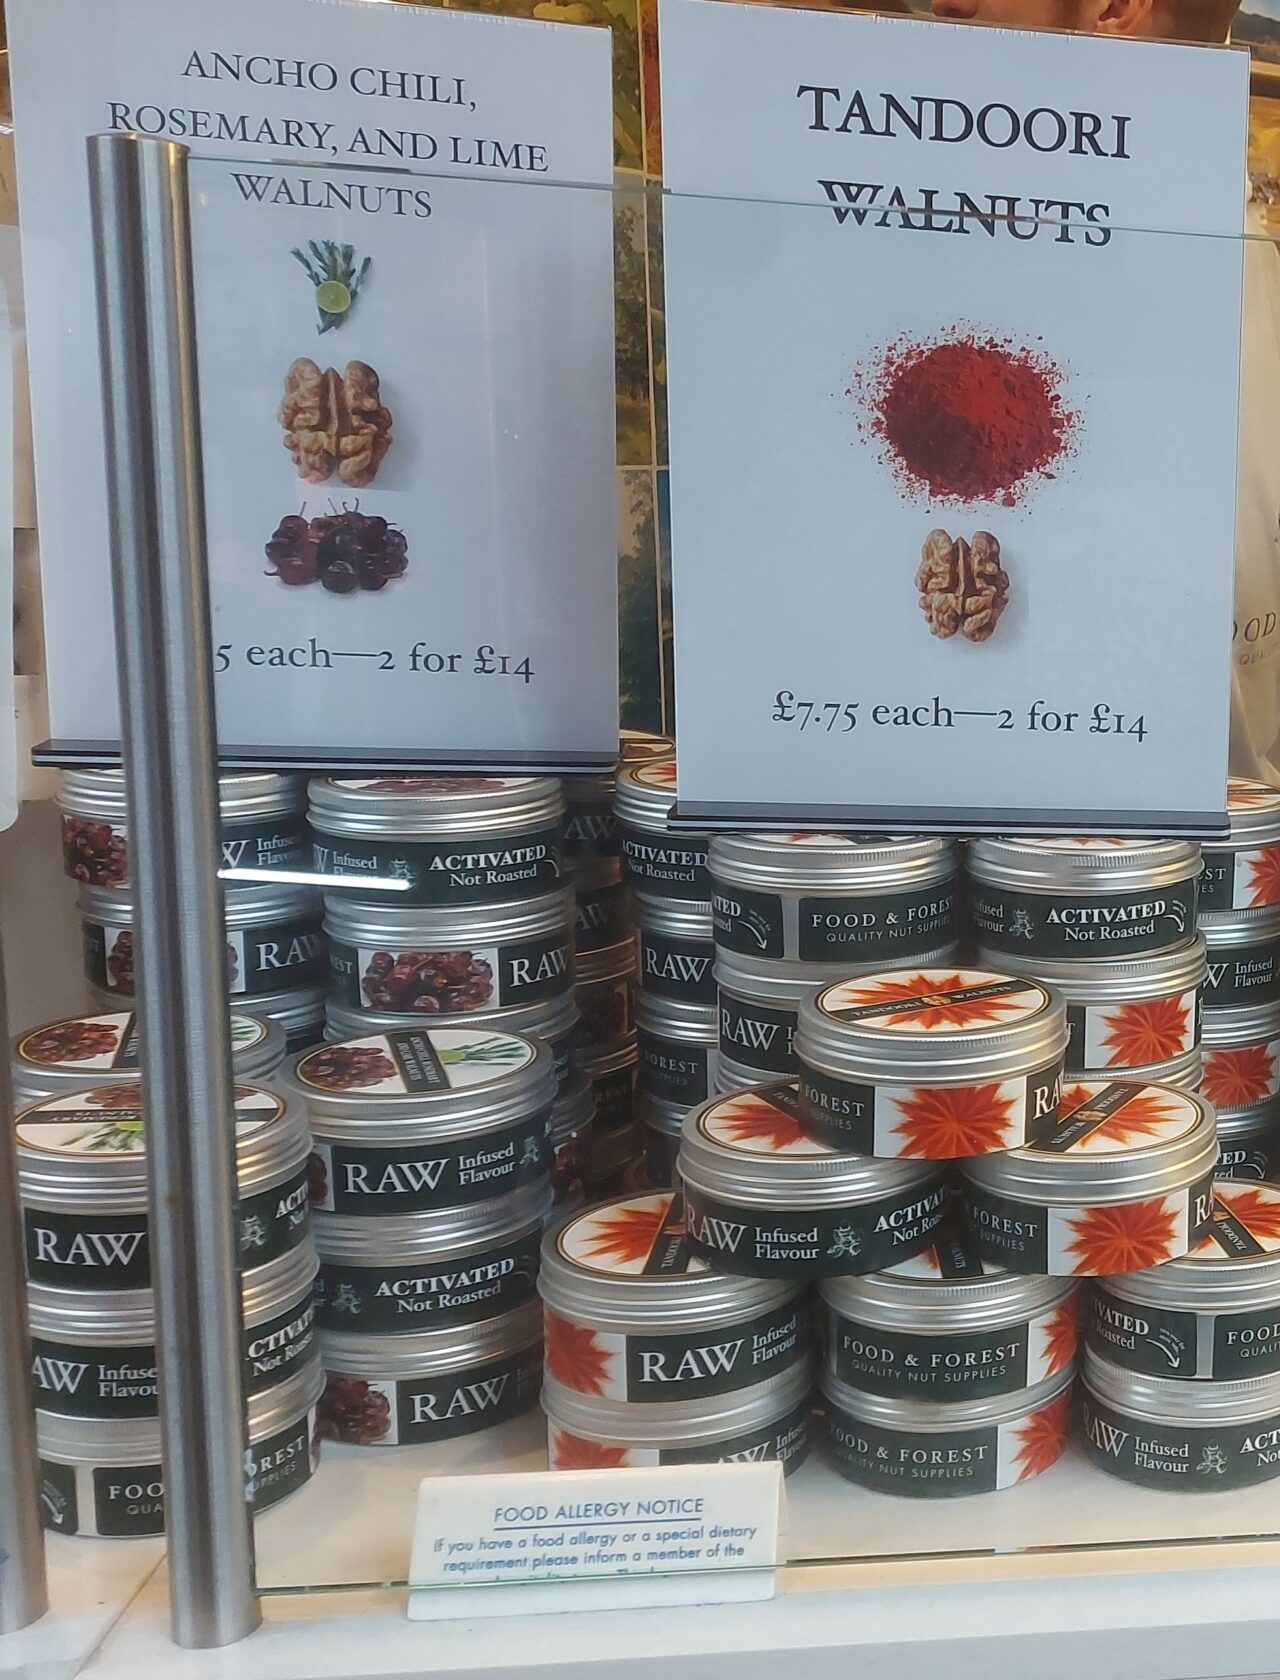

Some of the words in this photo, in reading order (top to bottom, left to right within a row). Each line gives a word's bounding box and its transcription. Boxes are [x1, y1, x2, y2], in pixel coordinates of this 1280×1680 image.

[181, 50, 338, 92] ANCHO
[349, 67, 478, 113] CHILI,
[107, 102, 340, 157] ROSEMARY,
[348, 126, 438, 160] AND
[449, 136, 549, 172] LIME
[796, 84, 1132, 160] TANDOORI
[229, 172, 433, 218] WALNUTS
[817, 179, 1113, 248] WALNUTS
[409, 643, 462, 673] for
[473, 645, 535, 683] £14
[772, 690, 859, 732] £7.75
[1027, 700, 1079, 732] for
[1089, 703, 1148, 743] £14
[429, 844, 546, 871] ACTIVATED
[449, 870, 481, 886] Not
[485, 866, 537, 885] Roasted
[811, 913, 876, 928] FOOD
[1046, 901, 1165, 924] ACTIVATED
[825, 930, 882, 944] QUALITY
[1064, 926, 1096, 942] Not
[1099, 921, 1154, 938] Roasted
[646, 948, 710, 983] RAW
[721, 1008, 780, 1051] RAW
[458, 1142, 514, 1170] Infused
[459, 1158, 514, 1186] Flavour
[342, 1158, 449, 1193] RAW
[34, 1228, 145, 1266] RAW
[754, 1226, 818, 1244] Infused
[755, 1244, 819, 1260] Flavour
[374, 1258, 514, 1297] ACTIVATED
[397, 1293, 433, 1313] Not
[438, 1281, 501, 1309] Roasted
[752, 1315, 797, 1348] Infused
[638, 1340, 745, 1383] RAW
[752, 1333, 797, 1365] Flavour
[843, 1335, 895, 1363] FOOD
[904, 1353, 918, 1367] &
[931, 1342, 1019, 1368] FOREST
[852, 1359, 901, 1380] QUALITY
[907, 1370, 936, 1383] NUT
[944, 1365, 1006, 1383] SUPPLIES
[410, 1374, 508, 1423] RAW
[898, 1444, 988, 1464] FOREST
[1134, 1436, 1189, 1458] Infused
[1134, 1452, 1190, 1473] Flavour
[494, 1505, 549, 1522] FOOD
[554, 1502, 629, 1521] ALLERGY
[636, 1498, 704, 1516] NOTICE
[433, 1538, 444, 1552] If
[448, 1541, 474, 1556] you
[478, 1535, 512, 1551] have
[518, 1538, 527, 1549] a
[531, 1532, 564, 1549] food
[569, 1529, 617, 1548] allergy
[623, 1532, 637, 1543] or
[641, 1531, 651, 1542] a
[655, 1526, 705, 1545] special
[709, 1525, 757, 1542] dietary
[443, 1555, 528, 1574] requirement
[532, 1551, 578, 1571] please
[583, 1549, 627, 1566] inform
[632, 1551, 642, 1562] a
[647, 1545, 701, 1562] member
[706, 1543, 721, 1559] of
[724, 1544, 745, 1558] the
